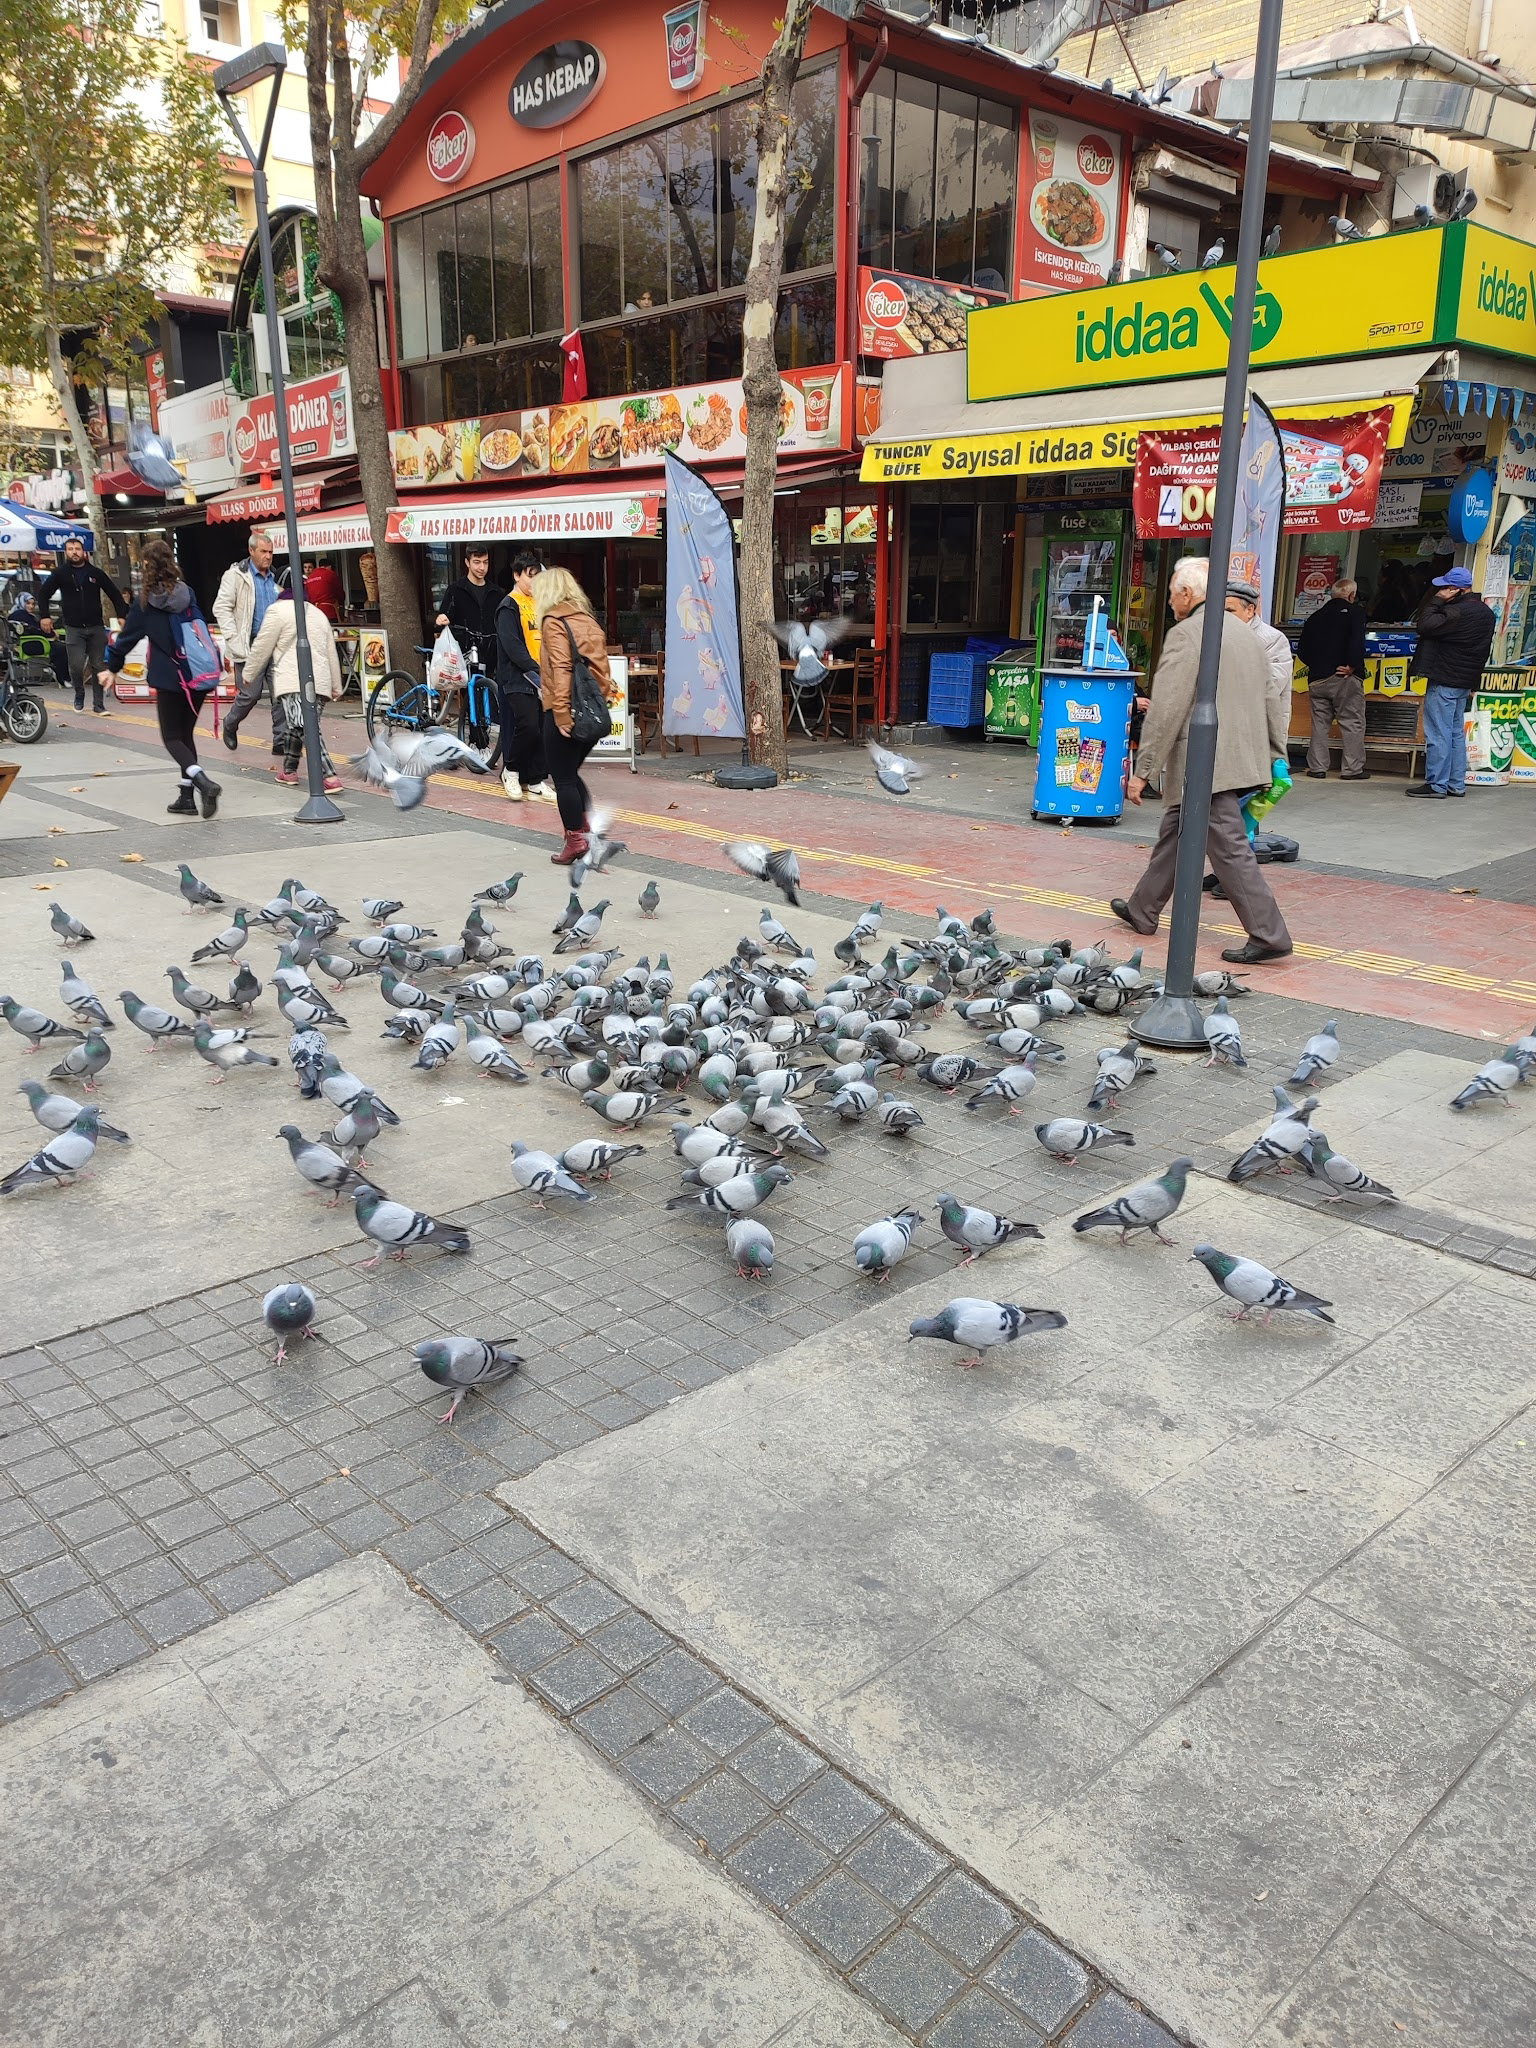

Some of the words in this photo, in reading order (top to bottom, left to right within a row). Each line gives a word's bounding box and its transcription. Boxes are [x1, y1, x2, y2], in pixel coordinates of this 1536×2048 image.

[513, 76, 544, 114] HAS
[545, 54, 595, 101] KEBAP
[434, 129, 466, 169] eker
[1083, 151, 1114, 174] eker
[1034, 247, 1075, 271] İSKENDER
[1074, 260, 1101, 276] KEBAP
[1050, 269, 1063, 281] HAS
[1063, 272, 1084, 285] KEBAP
[1477, 261, 1527, 322] iddaa
[871, 298, 905, 317] eker
[1075, 301, 1199, 363] iddaa
[289, 393, 329, 434] DÖNER
[1438, 420, 1463, 432] milli
[780, 439, 797, 447] Kalite
[1437, 431, 1482, 443] piyango
[874, 443, 933, 460] TUNCAY
[942, 441, 1021, 475] Sayısal
[1028, 438, 1093, 465] iddaa
[1101, 430, 1138, 464] Sig
[1160, 442, 1192, 452] YILBAŞI
[1180, 451, 1220, 464] TAMAM
[883, 463, 921, 477] BÜFE
[1149, 463, 1192, 476] DAĞITIM
[220, 501, 244, 517] KLASS
[249, 496, 278, 513] DÖNER
[1474, 499, 1484, 509] milli
[1283, 517, 1309, 525] MİLYAR
[1310, 516, 1320, 524] TL
[1473, 508, 1489, 519] piyango
[421, 517, 440, 536] HAS
[442, 516, 475, 535] KEBAP
[478, 514, 517, 534] IZGARA
[520, 509, 562, 533] DÖNER
[564, 510, 614, 532] SALONU
[1060, 514, 1087, 529] fuse
[1178, 523, 1205, 531] MİLYON
[273, 534, 286, 549] HAS
[308, 530, 332, 546] IZGARA
[333, 524, 356, 545] DÖNER
[1305, 579, 1327, 588] 400
[997, 674, 1030, 688] YAŞA
[1480, 672, 1519, 691] TUNCAY
[610, 723, 624, 736] BAP
